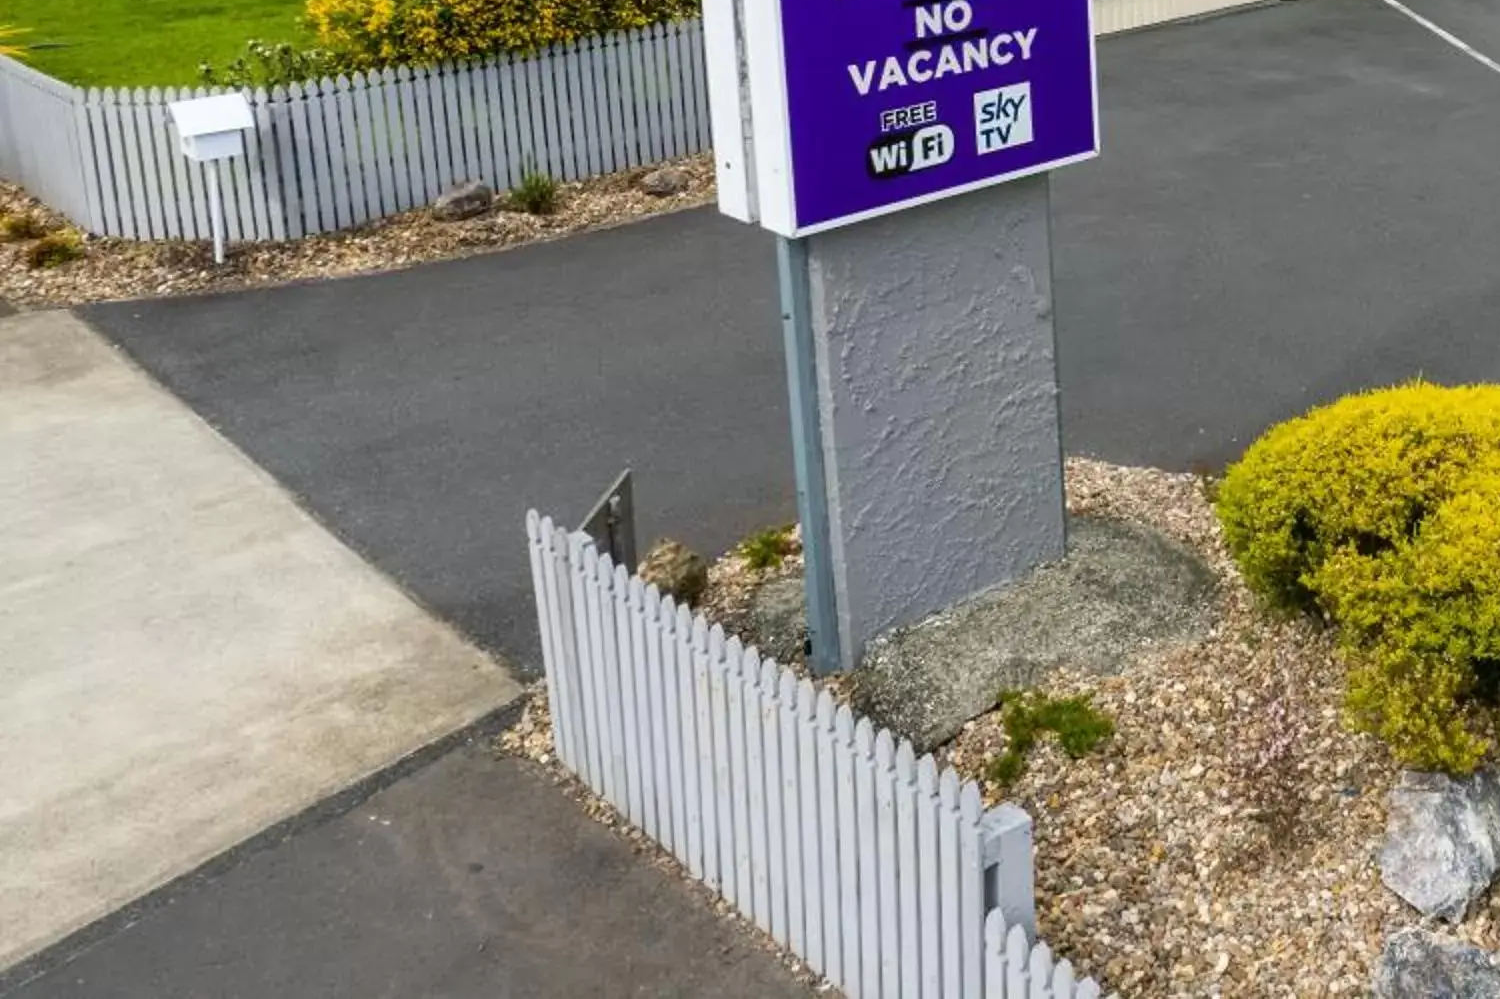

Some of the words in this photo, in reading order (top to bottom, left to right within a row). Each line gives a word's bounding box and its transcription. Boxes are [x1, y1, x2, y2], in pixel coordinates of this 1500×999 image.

[847, 27, 1038, 96] VACANCY
[880, 102, 936, 132] FREE
[980, 91, 1026, 124] sky
[980, 124, 1012, 150] TV
